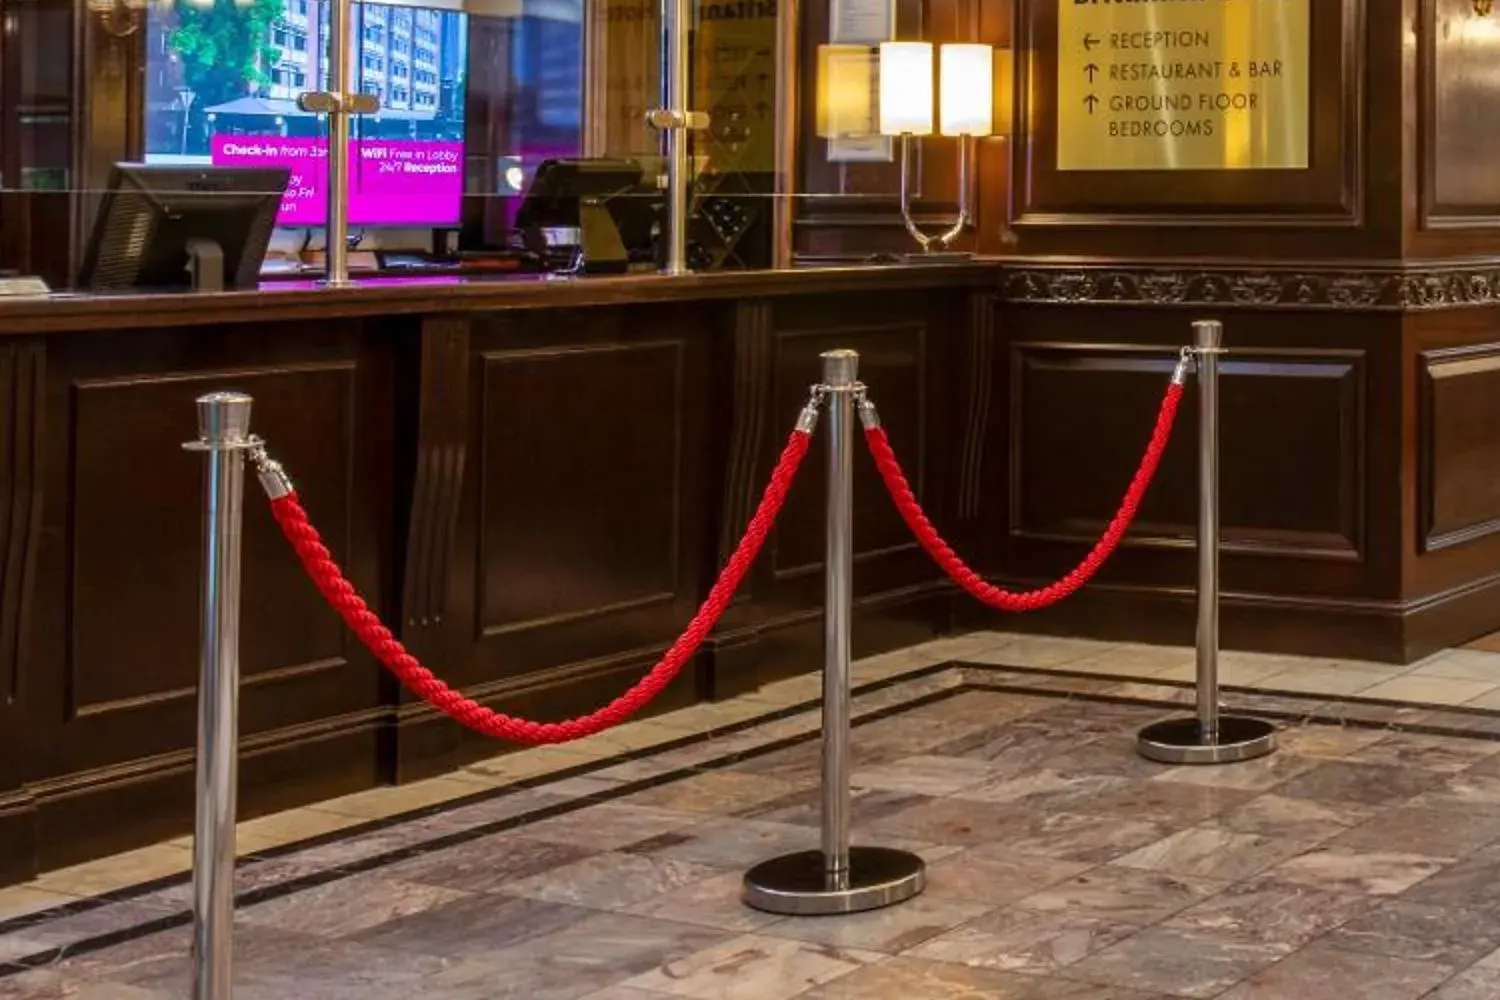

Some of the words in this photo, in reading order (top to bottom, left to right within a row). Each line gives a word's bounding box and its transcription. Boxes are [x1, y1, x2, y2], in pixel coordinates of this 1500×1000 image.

[1109, 30, 1210, 50] RECEPTION
[1109, 61, 1223, 81] RESTAURANT
[1229, 61, 1242, 78] &
[1248, 59, 1283, 78] BAR
[1109, 94, 1192, 113] GROUND
[1199, 92, 1259, 111] FLOOR
[1109, 119, 1214, 138] BEDROOMS
[223, 143, 278, 157] Check-in
